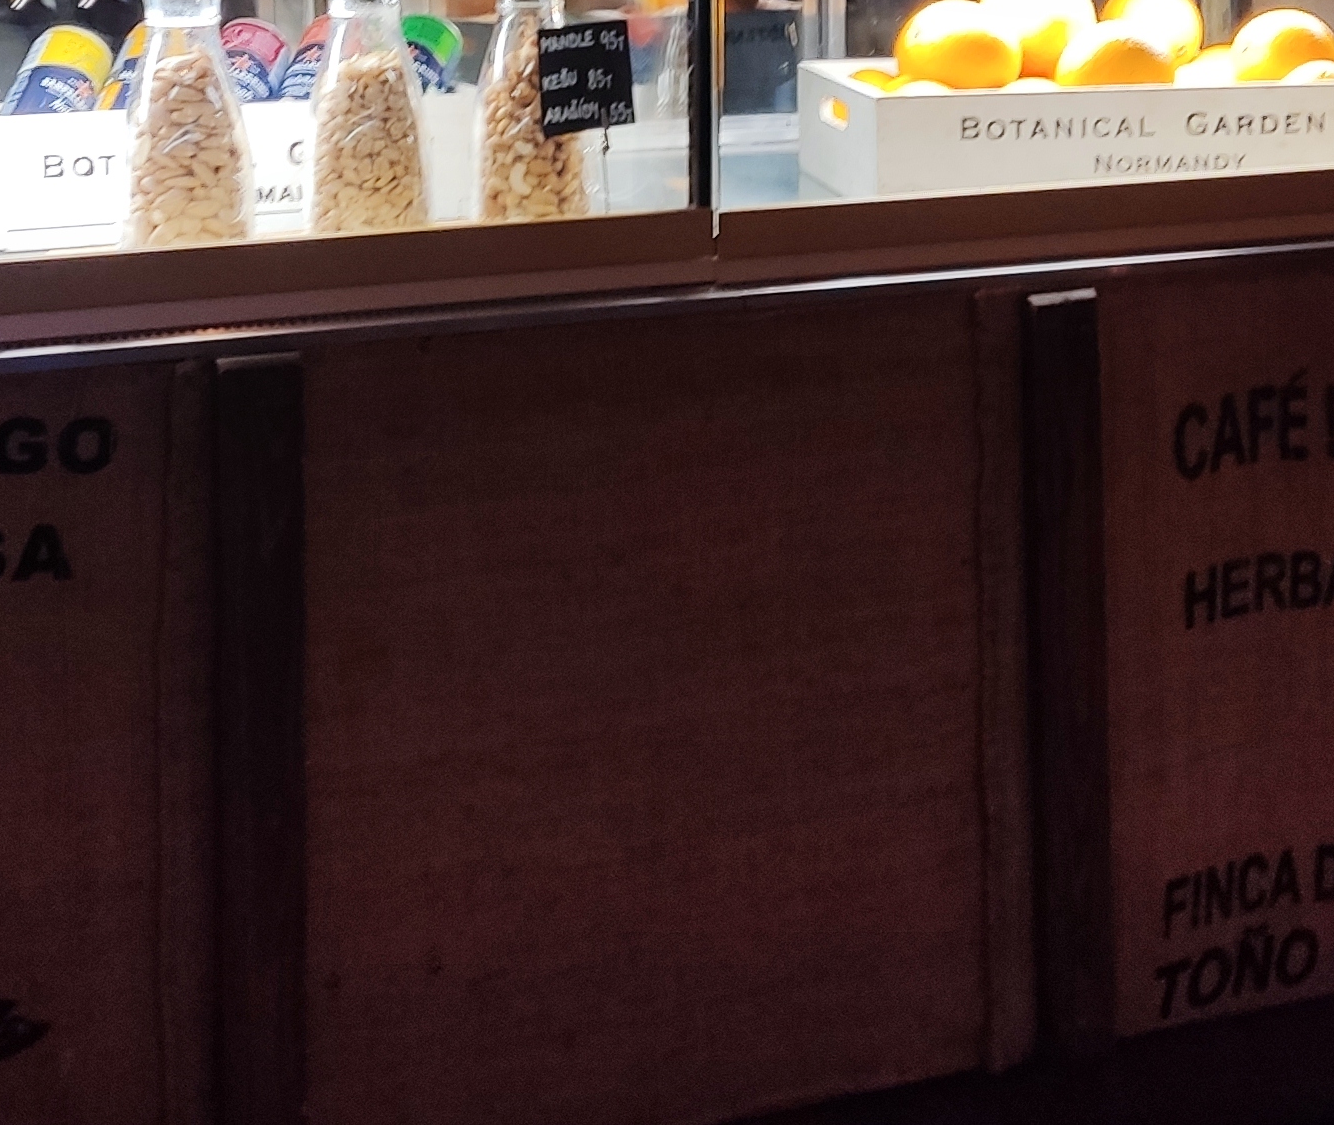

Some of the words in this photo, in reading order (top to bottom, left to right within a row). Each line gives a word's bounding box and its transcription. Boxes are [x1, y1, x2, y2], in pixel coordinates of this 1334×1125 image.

[959, 114, 1156, 143] BOTANICAL
[1185, 110, 1328, 139] GARDEN
[1092, 152, 1248, 176] NORMANDY
[1173, 367, 1309, 482] CAFÉ
[1166, 847, 1300, 937] FINCA
[1156, 927, 1318, 1018] TOÑO
